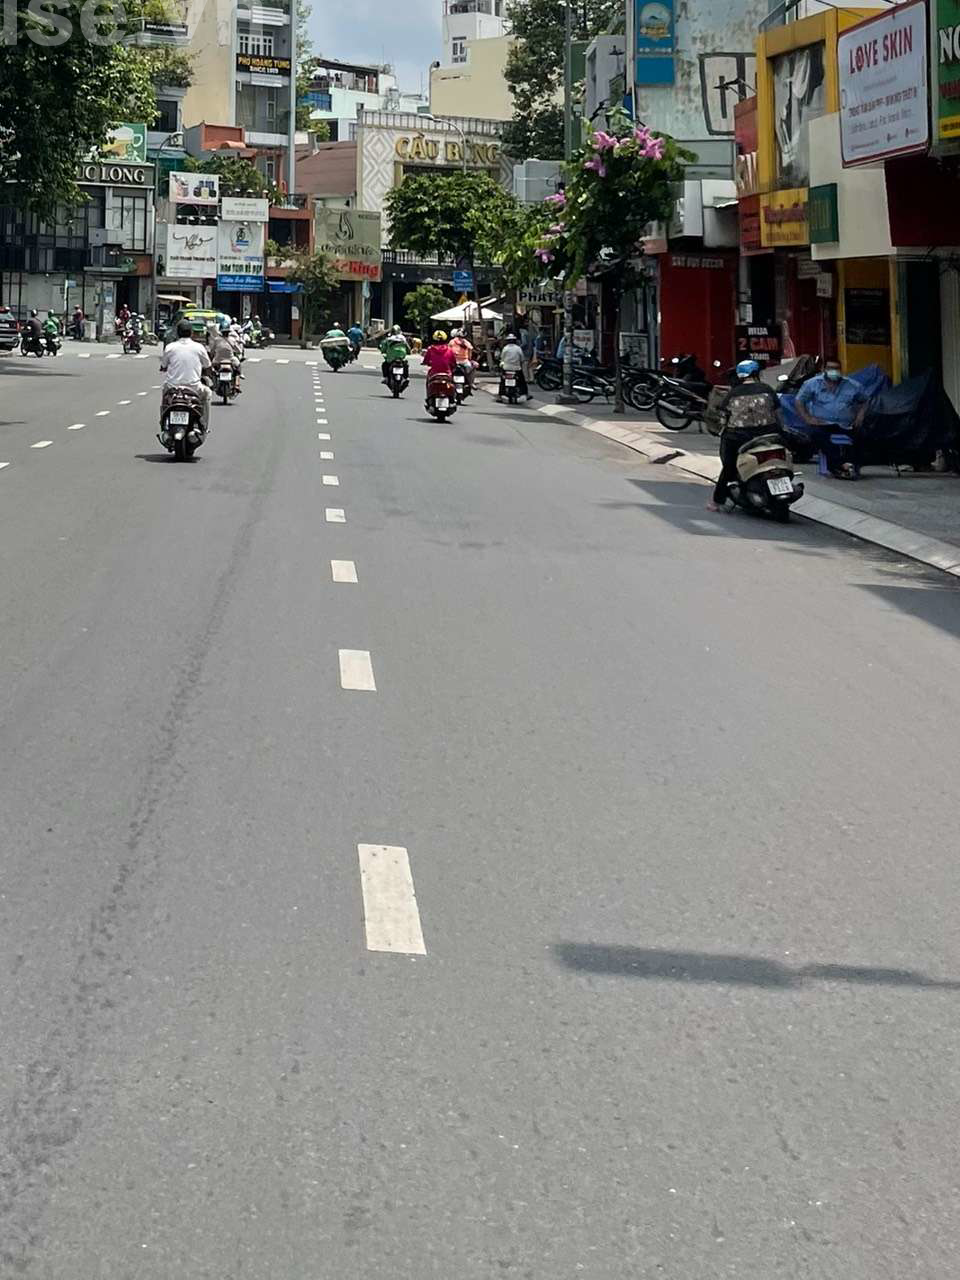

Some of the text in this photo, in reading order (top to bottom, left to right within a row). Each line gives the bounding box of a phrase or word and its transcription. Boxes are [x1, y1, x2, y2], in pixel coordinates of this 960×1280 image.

[849, 25, 913, 74] LOVE SKIN
[101, 166, 145, 183] LONG
